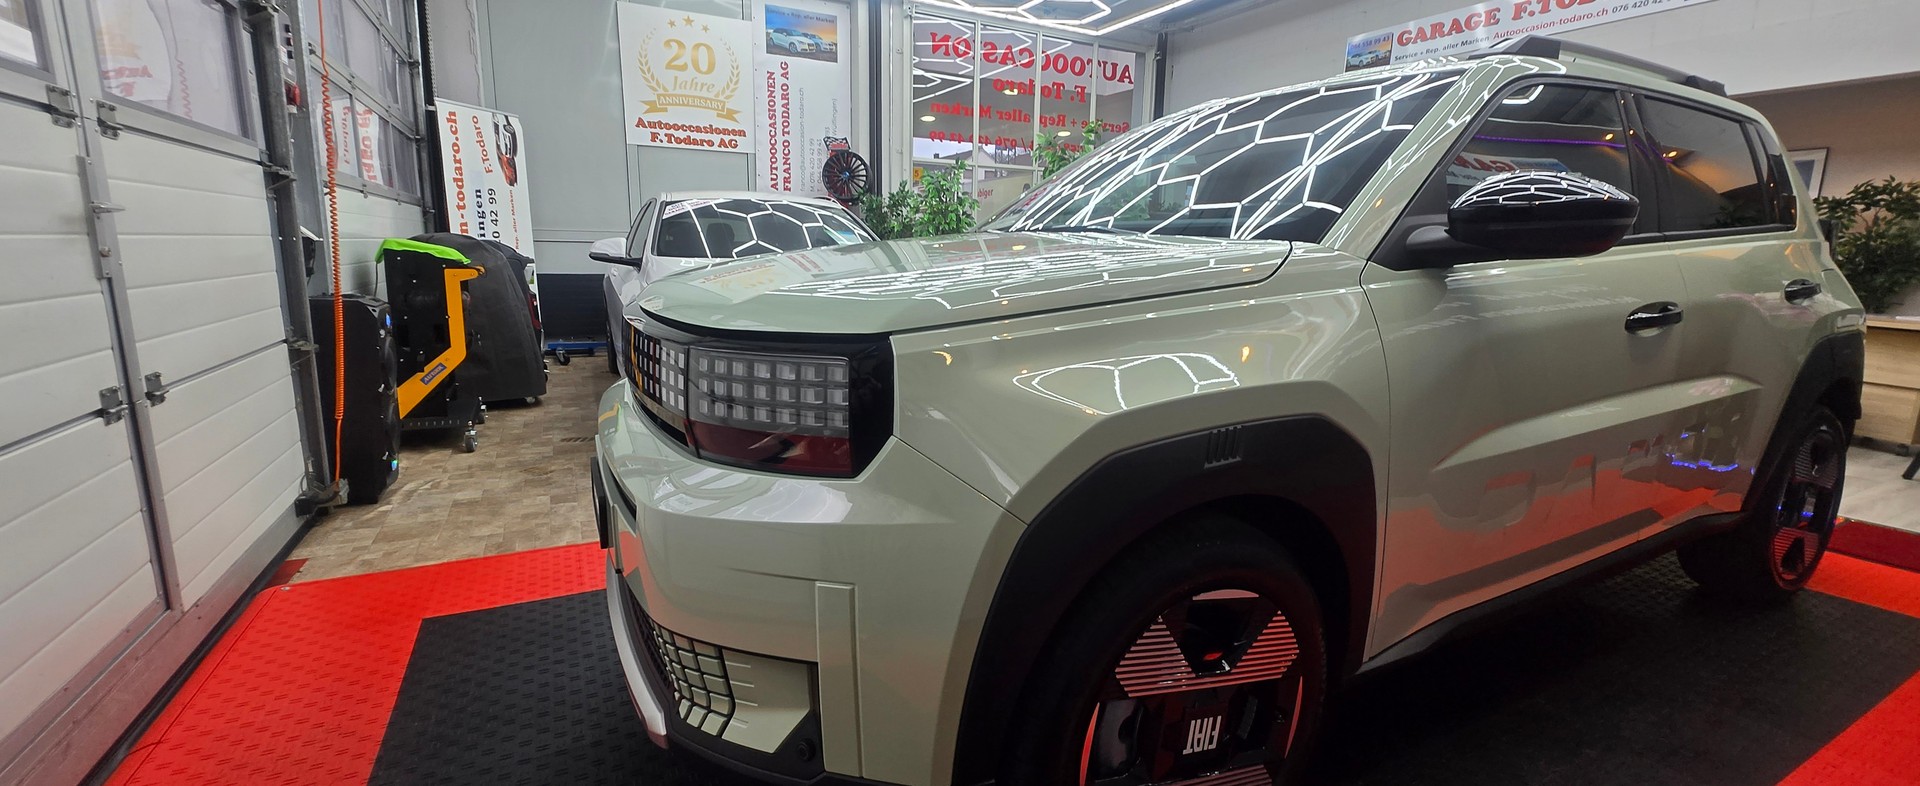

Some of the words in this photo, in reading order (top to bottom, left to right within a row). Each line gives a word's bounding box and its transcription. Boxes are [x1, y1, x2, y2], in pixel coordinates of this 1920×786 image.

[1395, 51, 1418, 61] Service
[1425, 46, 1440, 55] Rep.
[1442, 42, 1460, 51] aller
[1460, 37, 1490, 47] Marken
[1493, 7, 1608, 40] Autooccasion-todaro.ch
[1612, 4, 1629, 14] 076
[1631, 0, 1649, 9] 420
[1397, 8, 1500, 47] GARAGE
[663, 38, 716, 75] 20
[780, 61, 789, 80] AG
[659, 96, 724, 110] ANNIVERSARY
[672, 75, 715, 94] Jahre
[635, 117, 747, 138] Autooccasionen
[780, 82, 790, 136] TODARO
[472, 115, 493, 174] F.Todaro
[650, 131, 664, 143] F.
[664, 133, 715, 147] Todaro
[717, 138, 739, 149] AG
[767, 71, 779, 191] AUTOOCCASIONEN
[446, 111, 469, 235] n-todaro.ch
[782, 139, 791, 192] FRANCO
[475, 189, 486, 238] ingen
[487, 188, 497, 205] 99
[490, 210, 499, 227] 42
[1183, 715, 1222, 755] FIAT
